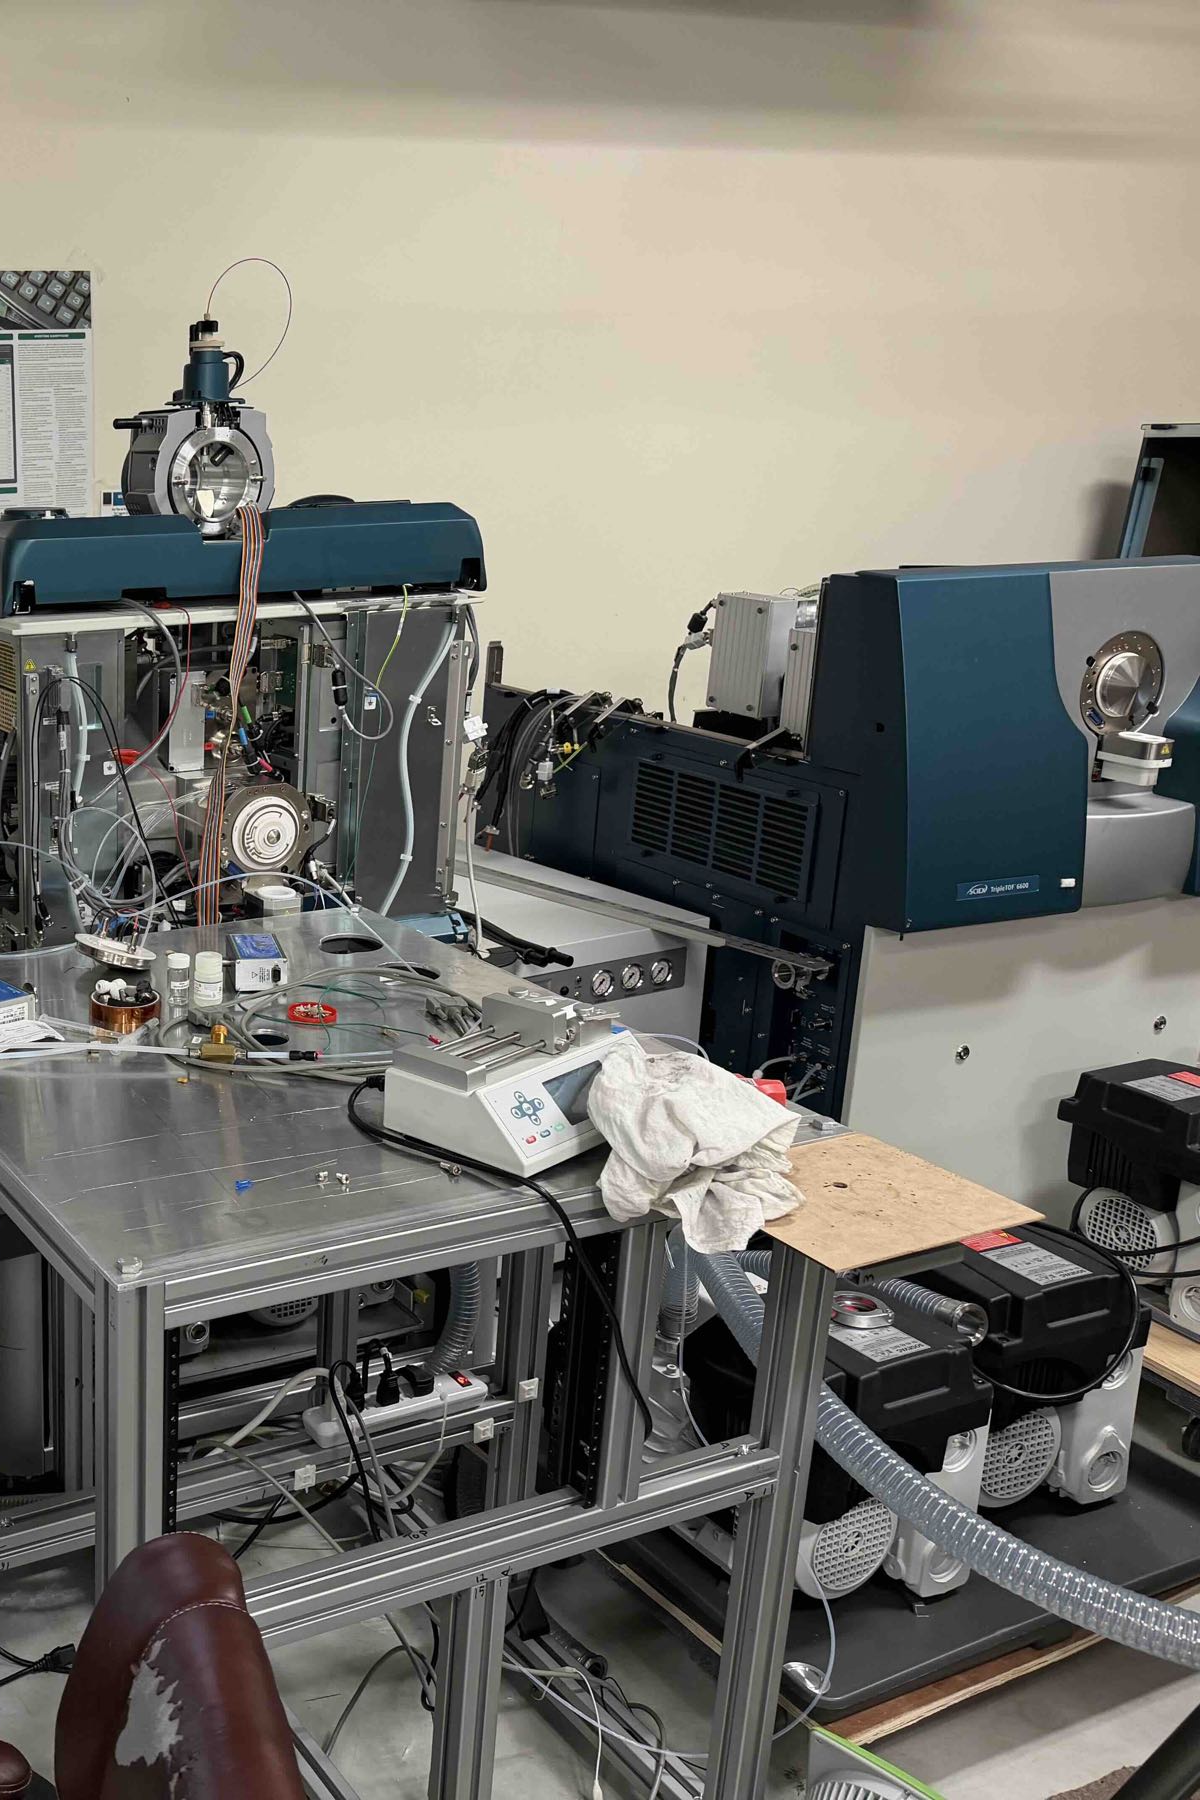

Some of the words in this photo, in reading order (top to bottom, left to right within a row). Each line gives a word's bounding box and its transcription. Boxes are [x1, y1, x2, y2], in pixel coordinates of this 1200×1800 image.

[53, 284, 62, 294] 2
[72, 296, 81, 304] 3
[1016, 882, 1029, 890] 6600
